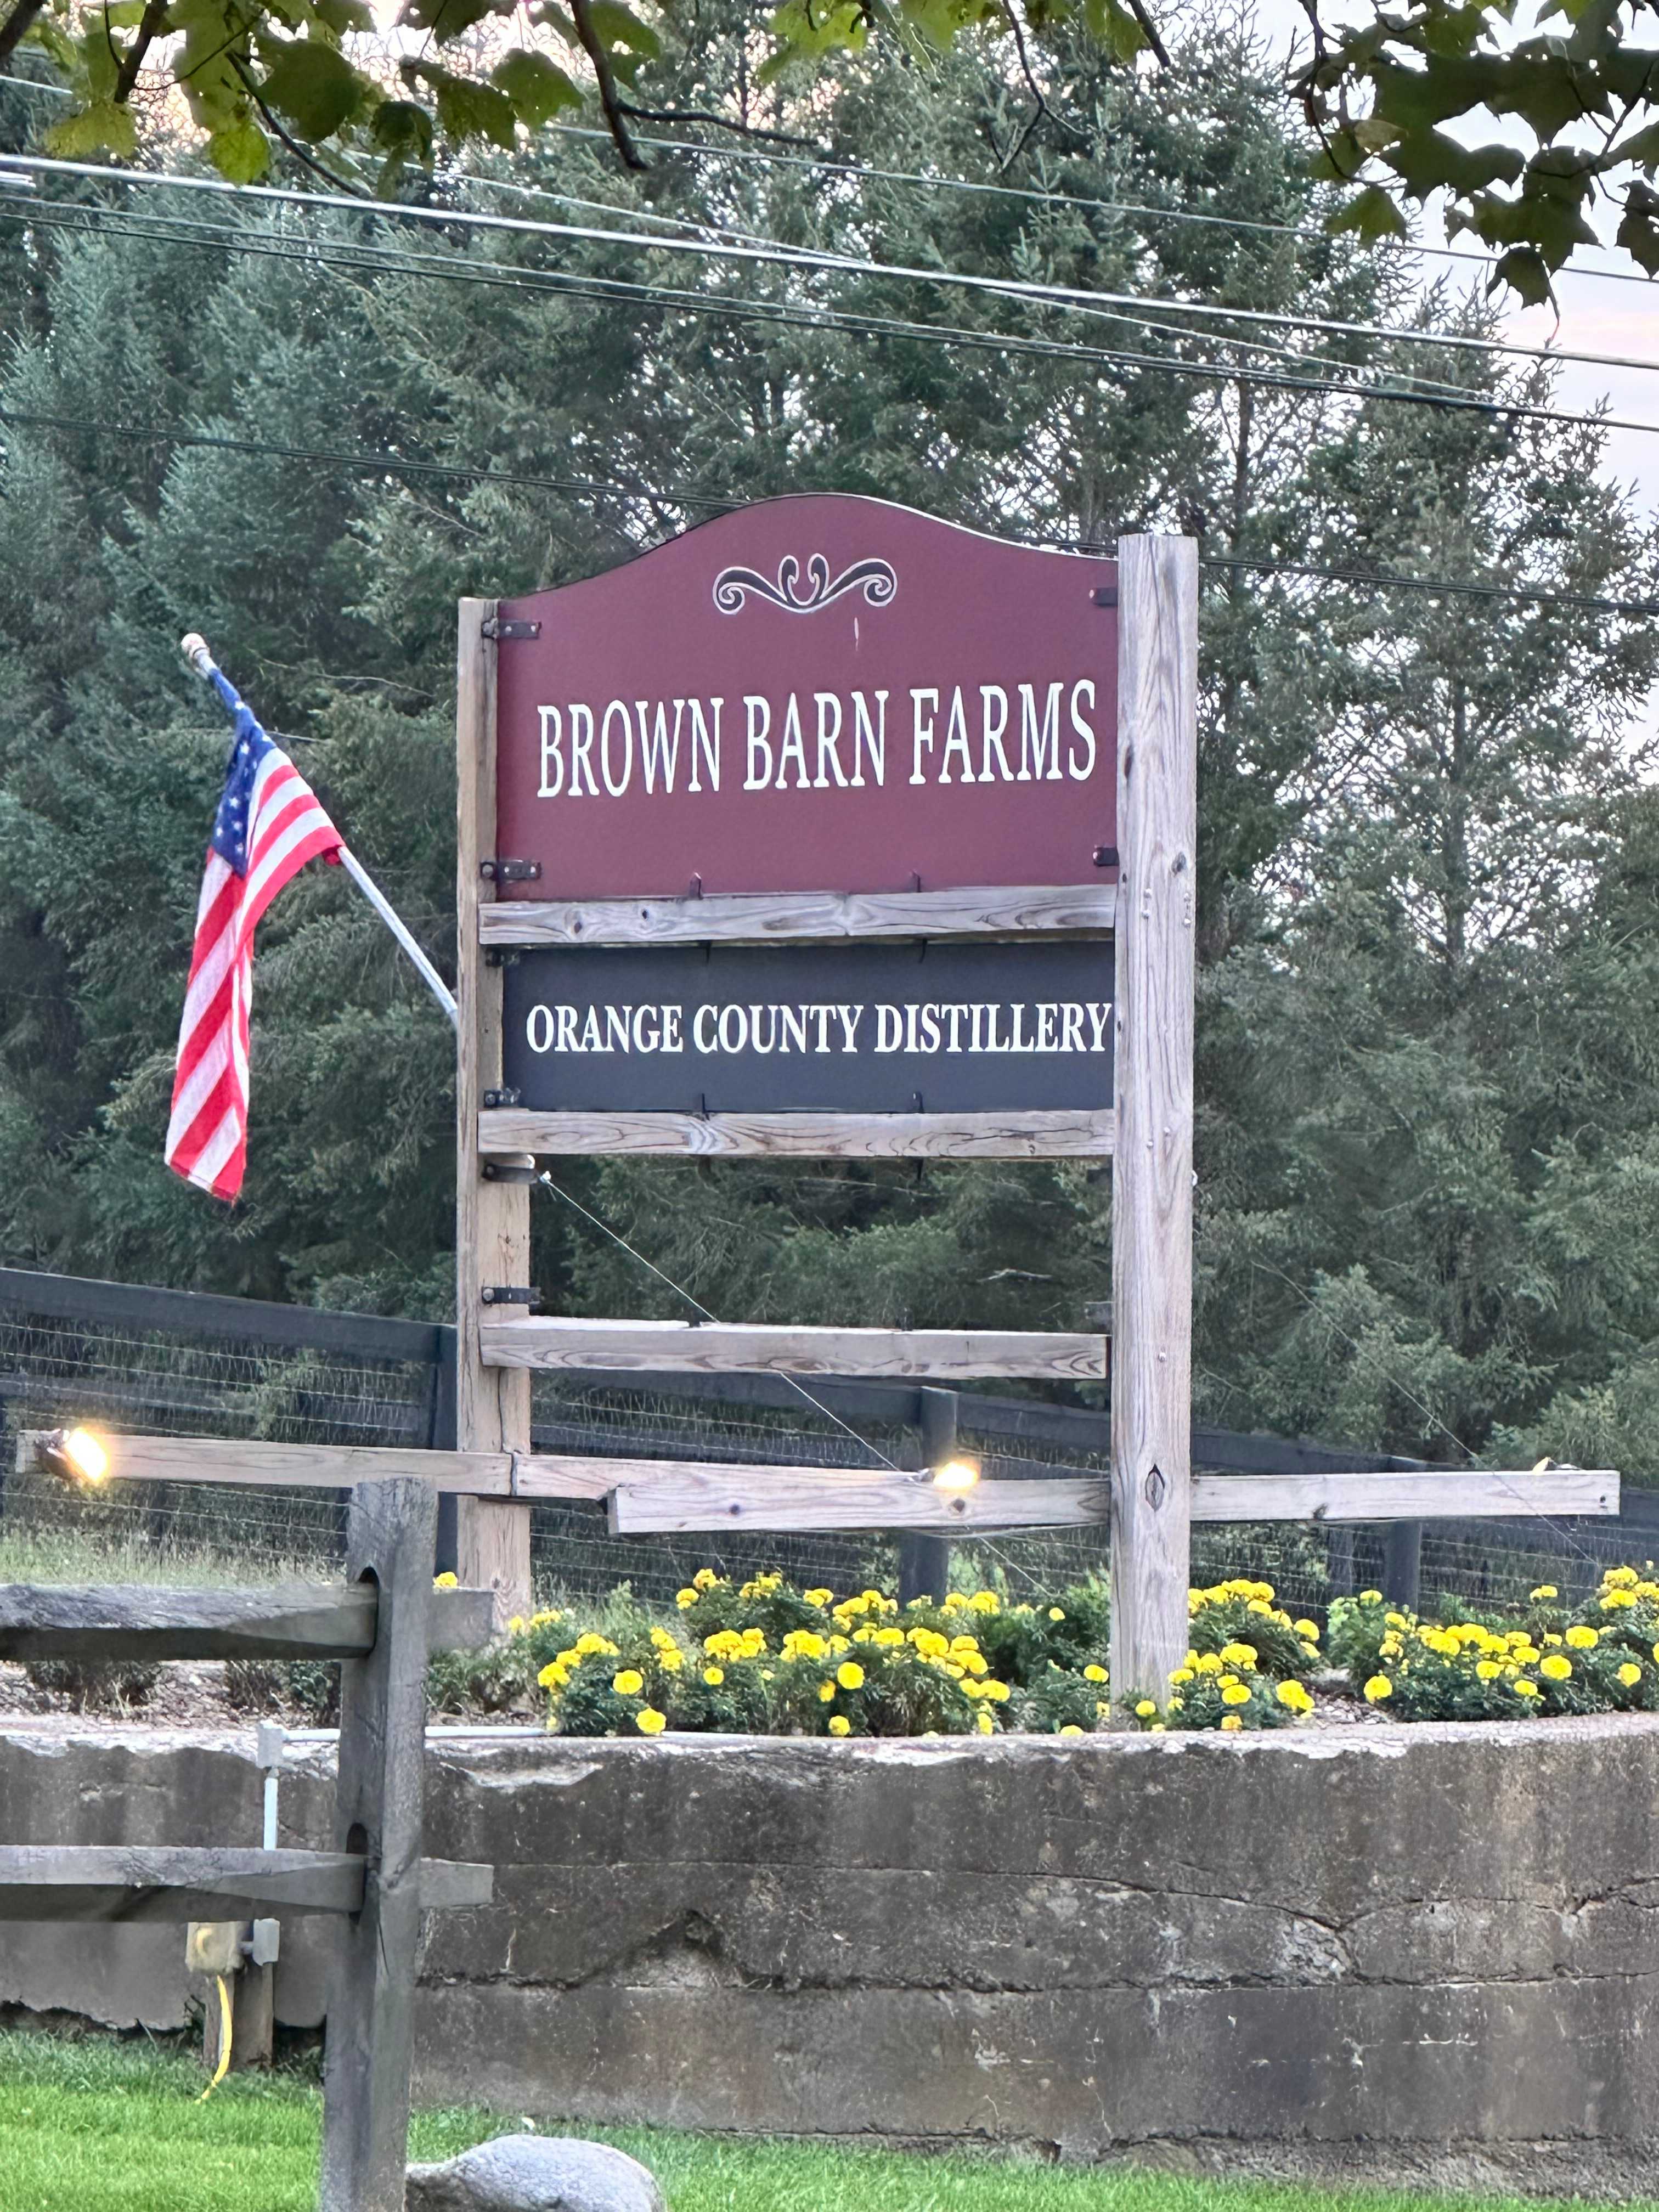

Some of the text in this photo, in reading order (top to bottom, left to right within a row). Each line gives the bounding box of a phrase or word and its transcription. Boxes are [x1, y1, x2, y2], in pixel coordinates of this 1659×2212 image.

[536, 679, 1097, 799] BROWN BARN FARMS
[525, 1002, 1114, 1055] ORANGE COUNTY DISTILLERY
